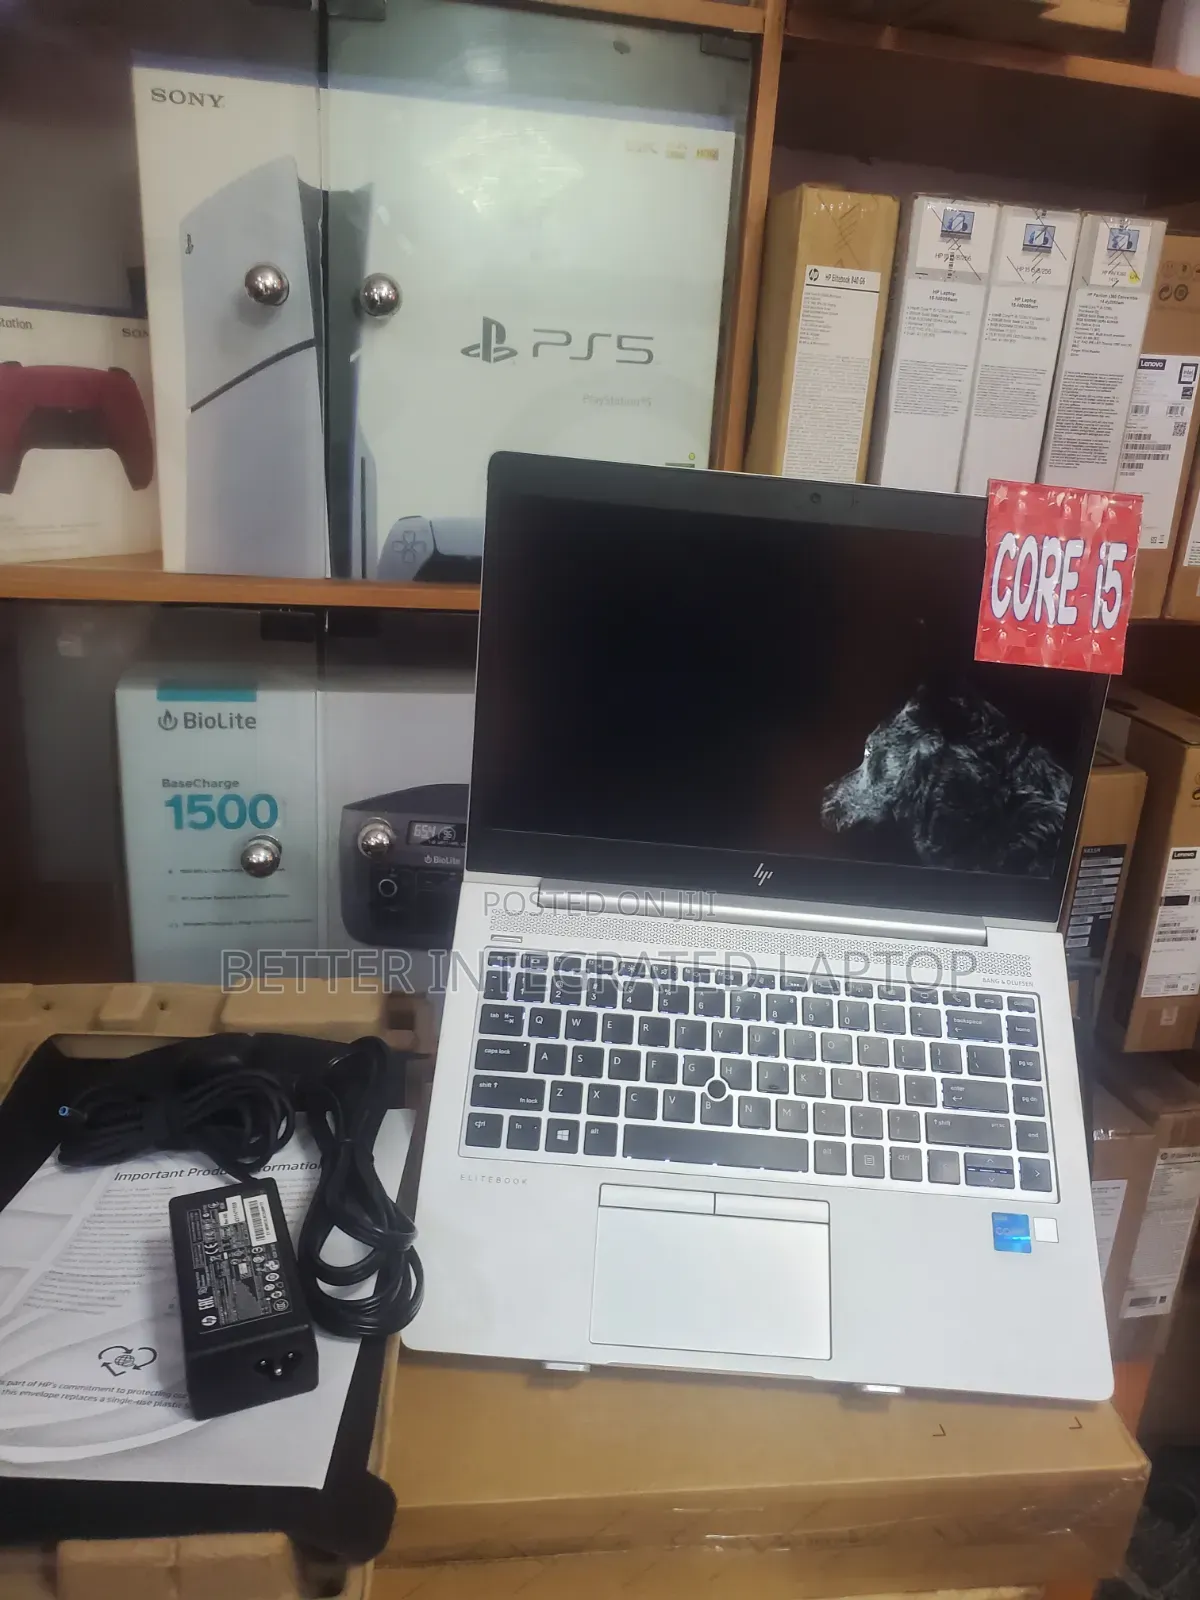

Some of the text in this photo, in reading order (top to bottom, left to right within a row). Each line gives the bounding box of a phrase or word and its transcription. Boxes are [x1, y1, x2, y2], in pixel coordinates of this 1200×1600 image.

[151, 87, 225, 109] SONY
[532, 328, 655, 365] PS5
[1140, 360, 1164, 368] Lenovo
[991, 532, 1128, 630] CORE i5
[183, 711, 257, 730] BioLite
[161, 778, 240, 790] BaseCharge
[164, 793, 279, 830] 1500
[433, 855, 461, 865] BioLite
[982, 977, 1000, 985] BANG
[1006, 979, 1034, 988] OLUFSEN
[555, 990, 561, 998] 2
[591, 993, 597, 1001] 3
[735, 1005, 741, 1013] 7
[772, 1010, 778, 1018] 8
[808, 1013, 814, 1021] 9
[535, 1015, 544, 1025] Q
[571, 1018, 582, 1027] W
[607, 1020, 613, 1029] E
[643, 1023, 649, 1032] R
[680, 1026, 686, 1035] T
[717, 1029, 724, 1038] Y
[754, 1034, 761, 1043] U
[863, 1044, 870, 1052] P
[541, 1052, 549, 1061] A
[577, 1054, 583, 1063] S
[614, 1056, 621, 1065] D
[651, 1060, 657, 1069] F
[688, 1063, 695, 1072] G
[725, 1066, 732, 1075] H
[763, 1070, 769, 1079] J
[800, 1073, 807, 1082] K
[556, 1088, 564, 1097] Z
[592, 1090, 600, 1099] X
[630, 1093, 637, 1102] C
[668, 1096, 676, 1105] V
[705, 1101, 711, 1110] B
[745, 1105, 752, 1113] N
[782, 1108, 792, 1117] M
[474, 1120, 486, 1128] ctrl
[515, 1122, 522, 1130] fn
[590, 1127, 599, 1135] alt
[113, 1168, 185, 1182] Important
[186, 1167, 228, 1177] Produ
[460, 1173, 528, 1185] ELITEBOOK
[38, 1381, 57, 1389] HP's
[58, 1384, 115, 1393] commitment
[126, 1388, 172, 1400] protecting
[19, 1390, 60, 1399] envelope
[60, 1393, 98, 1402] replaces
[106, 1396, 153, 1407] single-use
[153, 1400, 182, 1409] plastic
